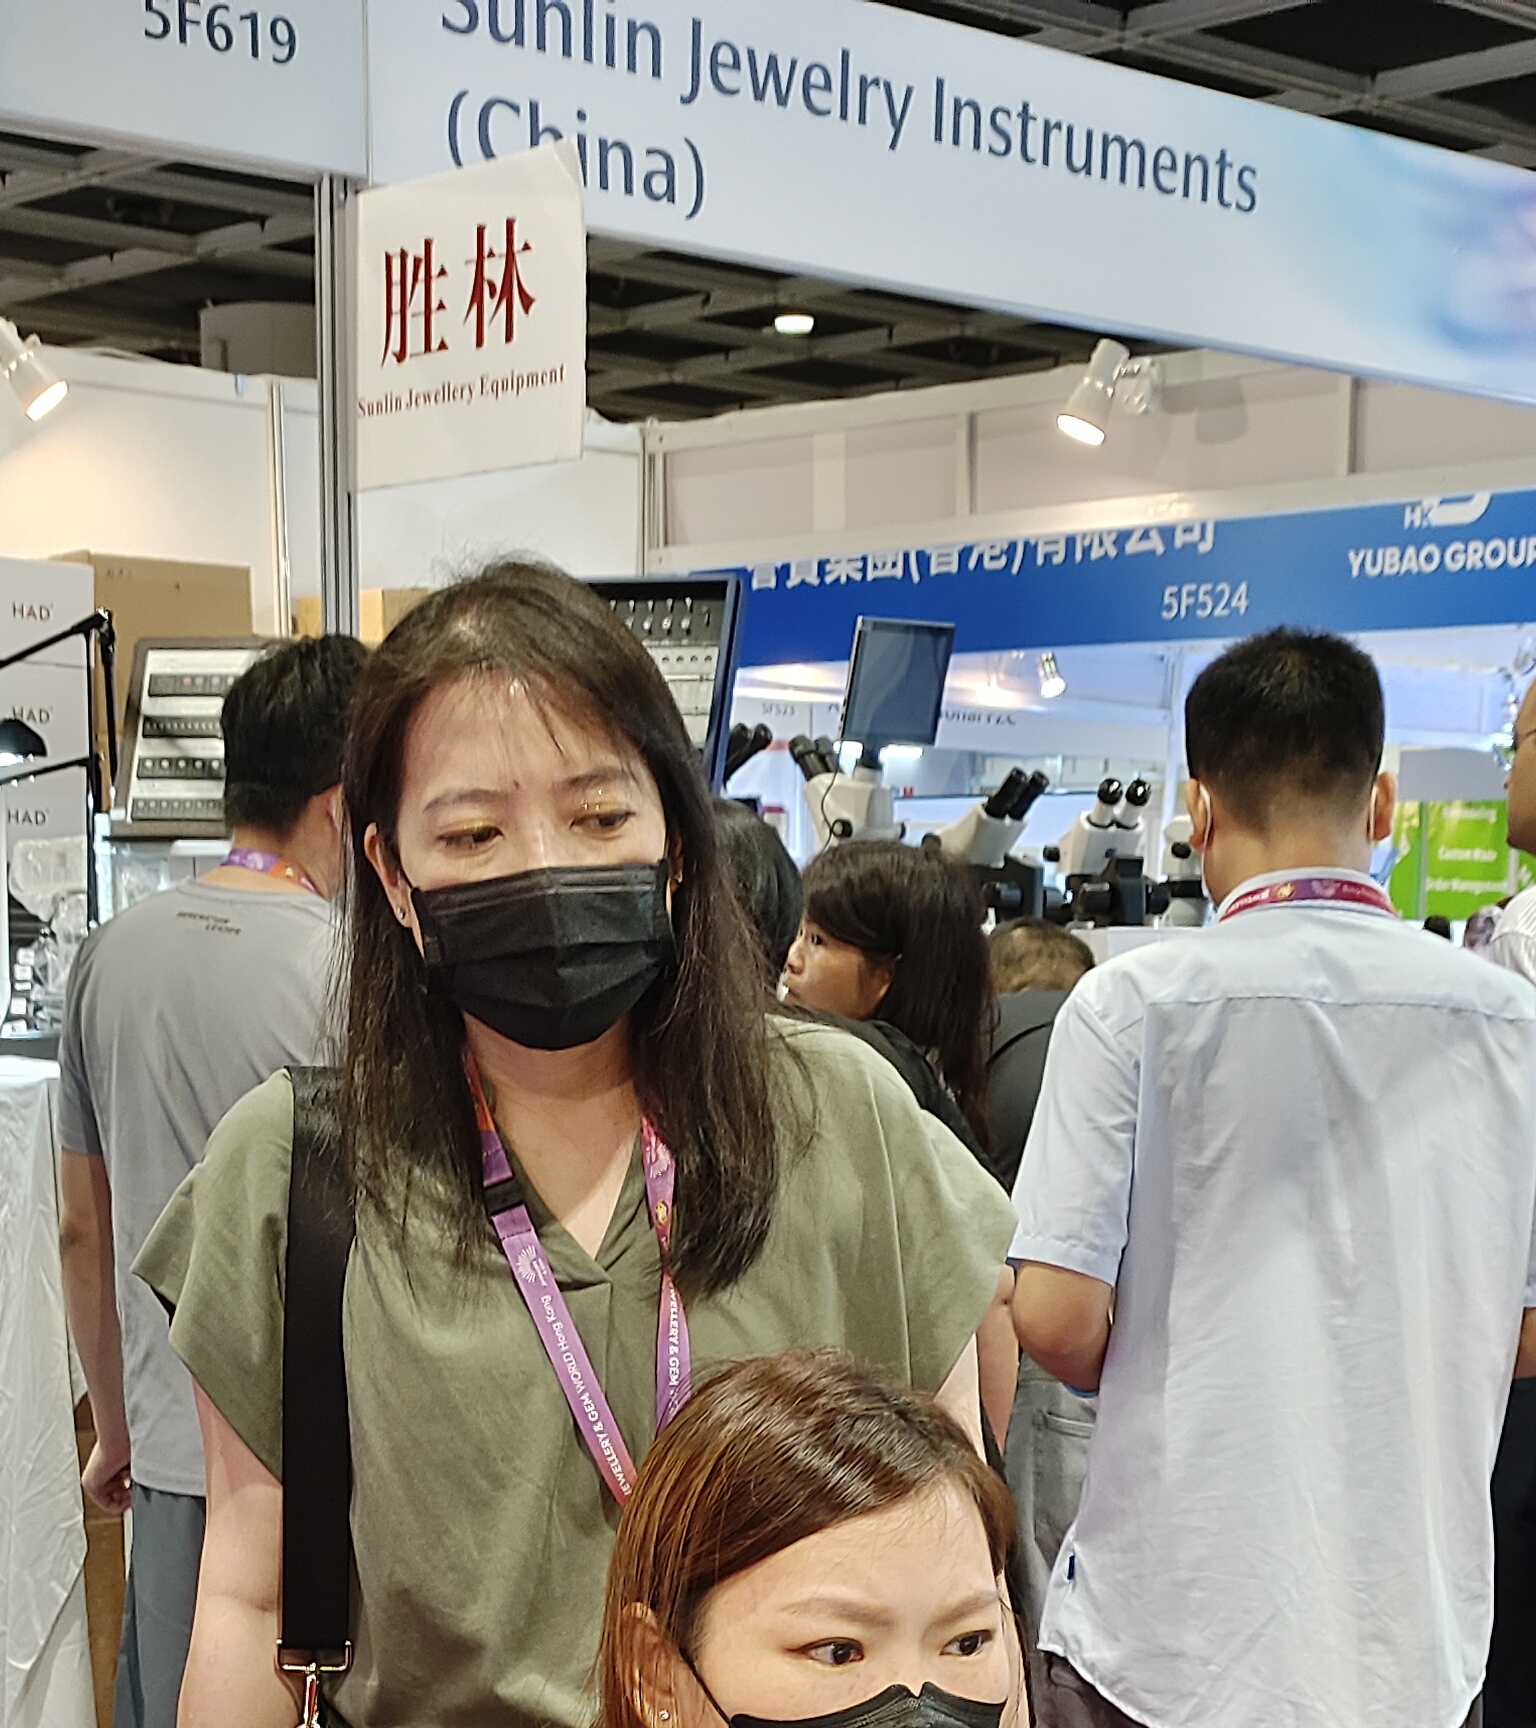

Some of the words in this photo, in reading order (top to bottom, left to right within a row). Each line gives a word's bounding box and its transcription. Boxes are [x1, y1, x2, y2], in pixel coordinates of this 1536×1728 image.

[144, 0, 297, 63] 5F619
[680, 17, 914, 151] Jewelry
[934, 77, 1258, 214] Instruments
[447, 90, 704, 220] (China)
[380, 217, 536, 368] 胜林
[357, 391, 402, 419] Sunlin
[405, 380, 476, 410] Jewellery
[480, 363, 566, 401] Equipment
[1348, 541, 1441, 578] YUBAO
[12, 602, 51, 621] HAD
[1161, 582, 1249, 620] 5F524
[7, 808, 47, 826] HAD
[540, 1295, 557, 1323] Kong
[551, 1322, 570, 1352] Hong
[563, 1352, 587, 1394] WORLD
[666, 1357, 681, 1386] GEM
[580, 1392, 600, 1422] GEM
